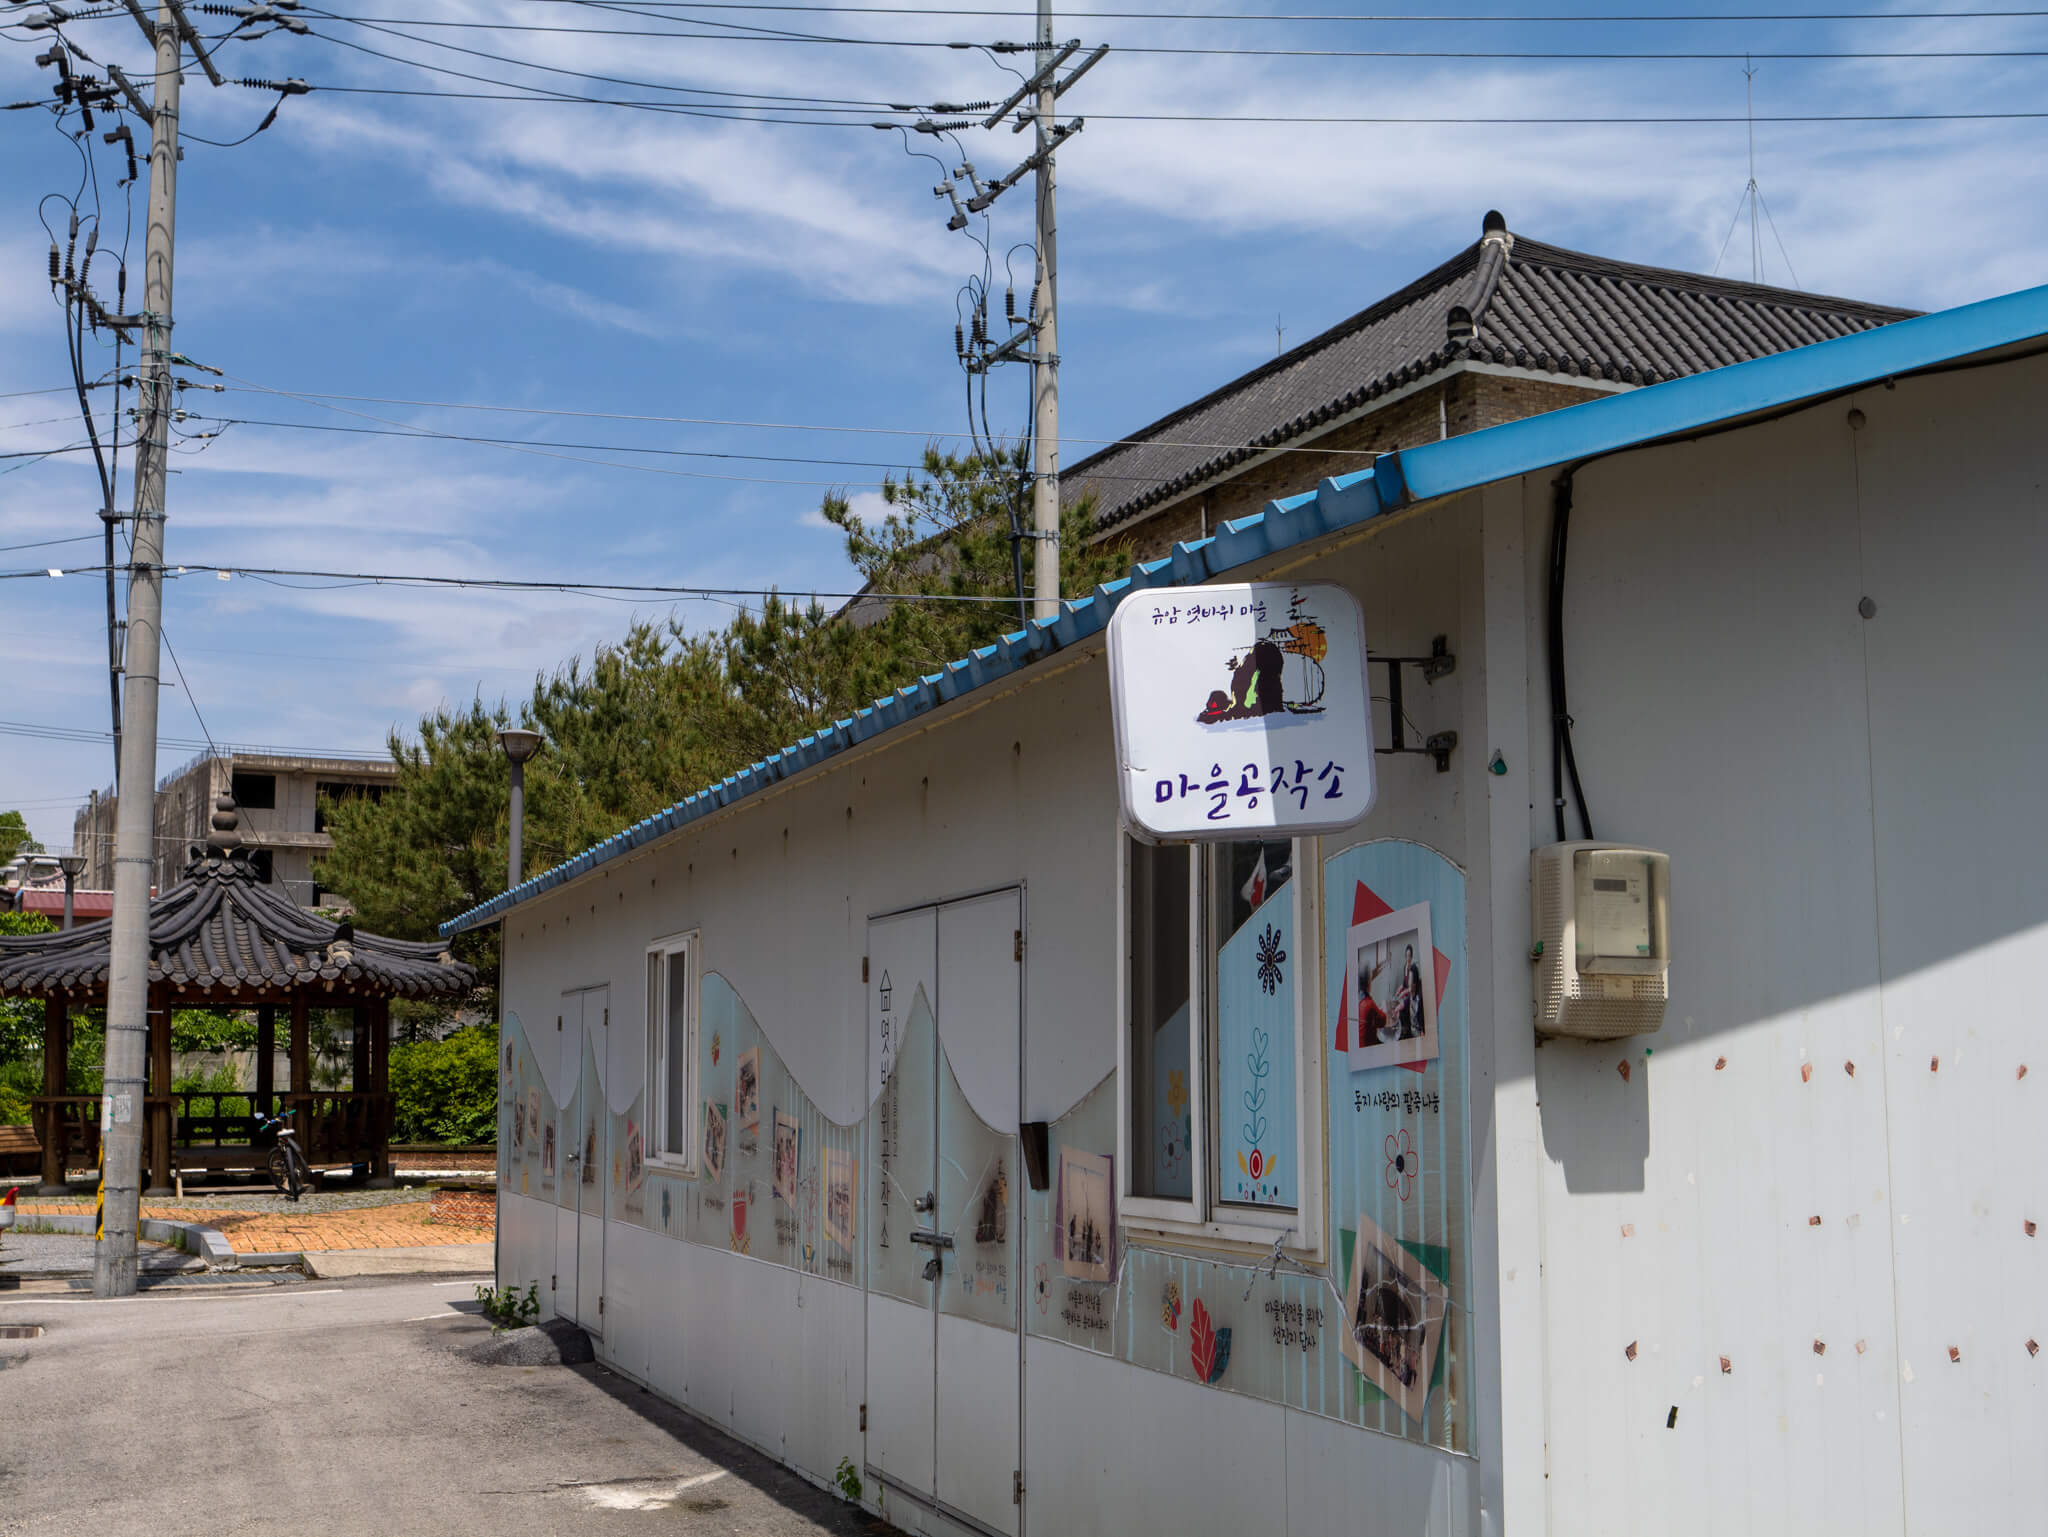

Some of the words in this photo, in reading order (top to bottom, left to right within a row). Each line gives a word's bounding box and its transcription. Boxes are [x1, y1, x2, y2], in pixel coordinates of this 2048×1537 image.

[1152, 607, 1181, 626] 규암
[1187, 604, 1233, 625] 엿바위
[1240, 601, 1267, 622] 마을
[1155, 760, 1345, 820] 마을공작소
[1354, 1090, 1371, 1112] 동지
[1373, 1091, 1400, 1112] 사랑의
[1306, 1307, 1324, 1328] 위한
[1299, 1330, 1316, 1352] 답사
